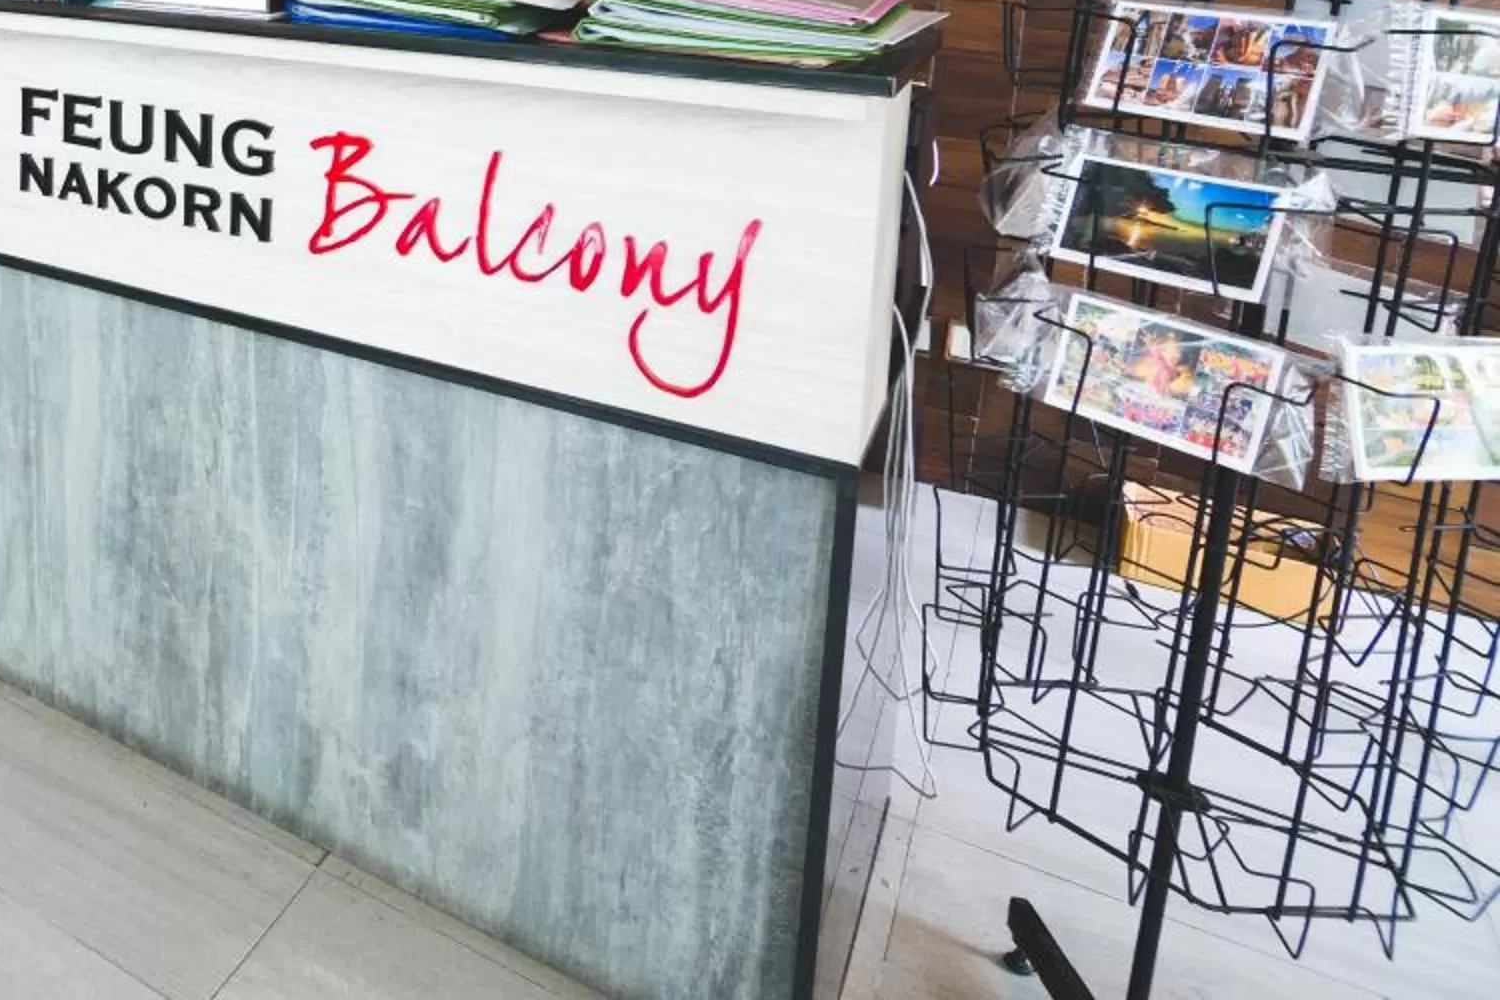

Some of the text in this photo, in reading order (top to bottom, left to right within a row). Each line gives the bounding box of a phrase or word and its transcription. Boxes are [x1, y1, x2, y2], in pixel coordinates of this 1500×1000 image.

[20, 86, 276, 177] FEUNG
[19, 152, 273, 243] NAKORN
[308, 131, 763, 398] Balcony
